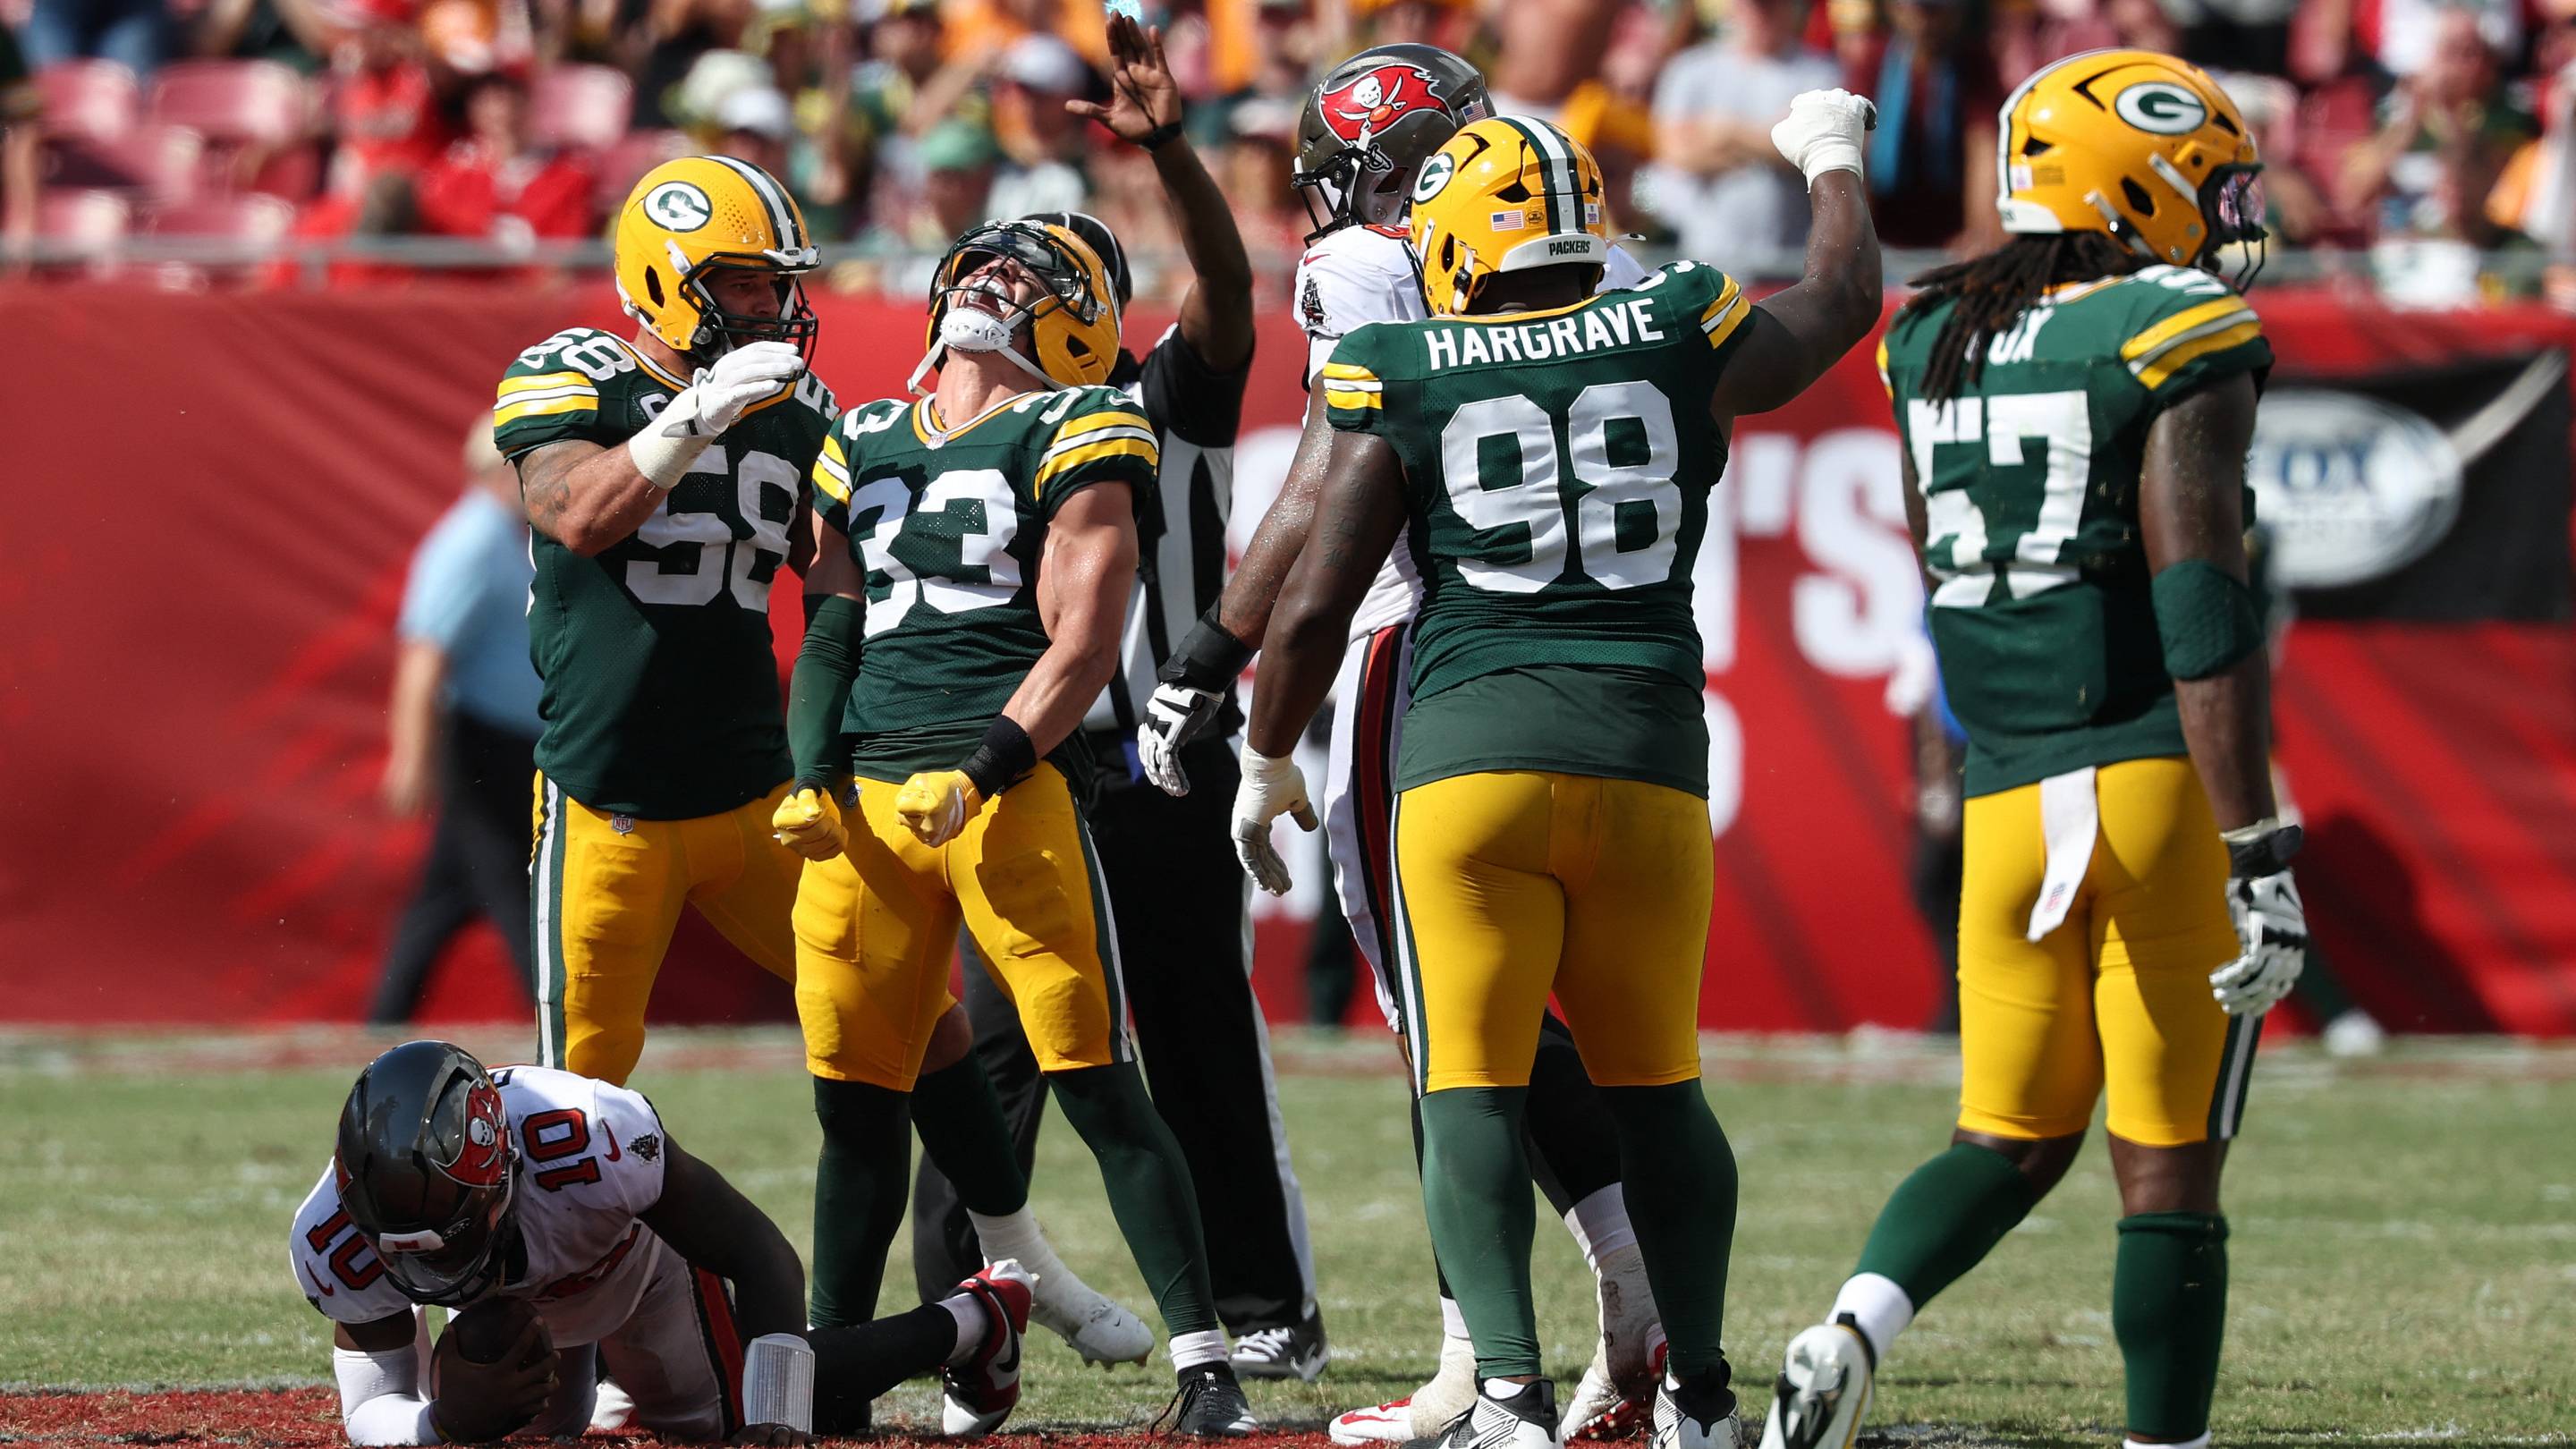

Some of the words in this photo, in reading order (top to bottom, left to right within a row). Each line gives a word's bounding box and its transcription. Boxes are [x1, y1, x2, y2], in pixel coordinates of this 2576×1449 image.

[2115, 80, 2207, 135] G
[644, 181, 712, 233] G
[1413, 152, 1455, 205] G
[1548, 240, 1591, 257] PACKERS
[1423, 297, 1665, 371] HARGRAVE
[1964, 306, 2055, 367] OX
[1440, 379, 1680, 594] 98
[1907, 389, 2093, 609] 57
[625, 444, 801, 614] 58
[848, 468, 1024, 640] 33
[521, 1106, 602, 1193] 10
[305, 1202, 386, 1292] 10
